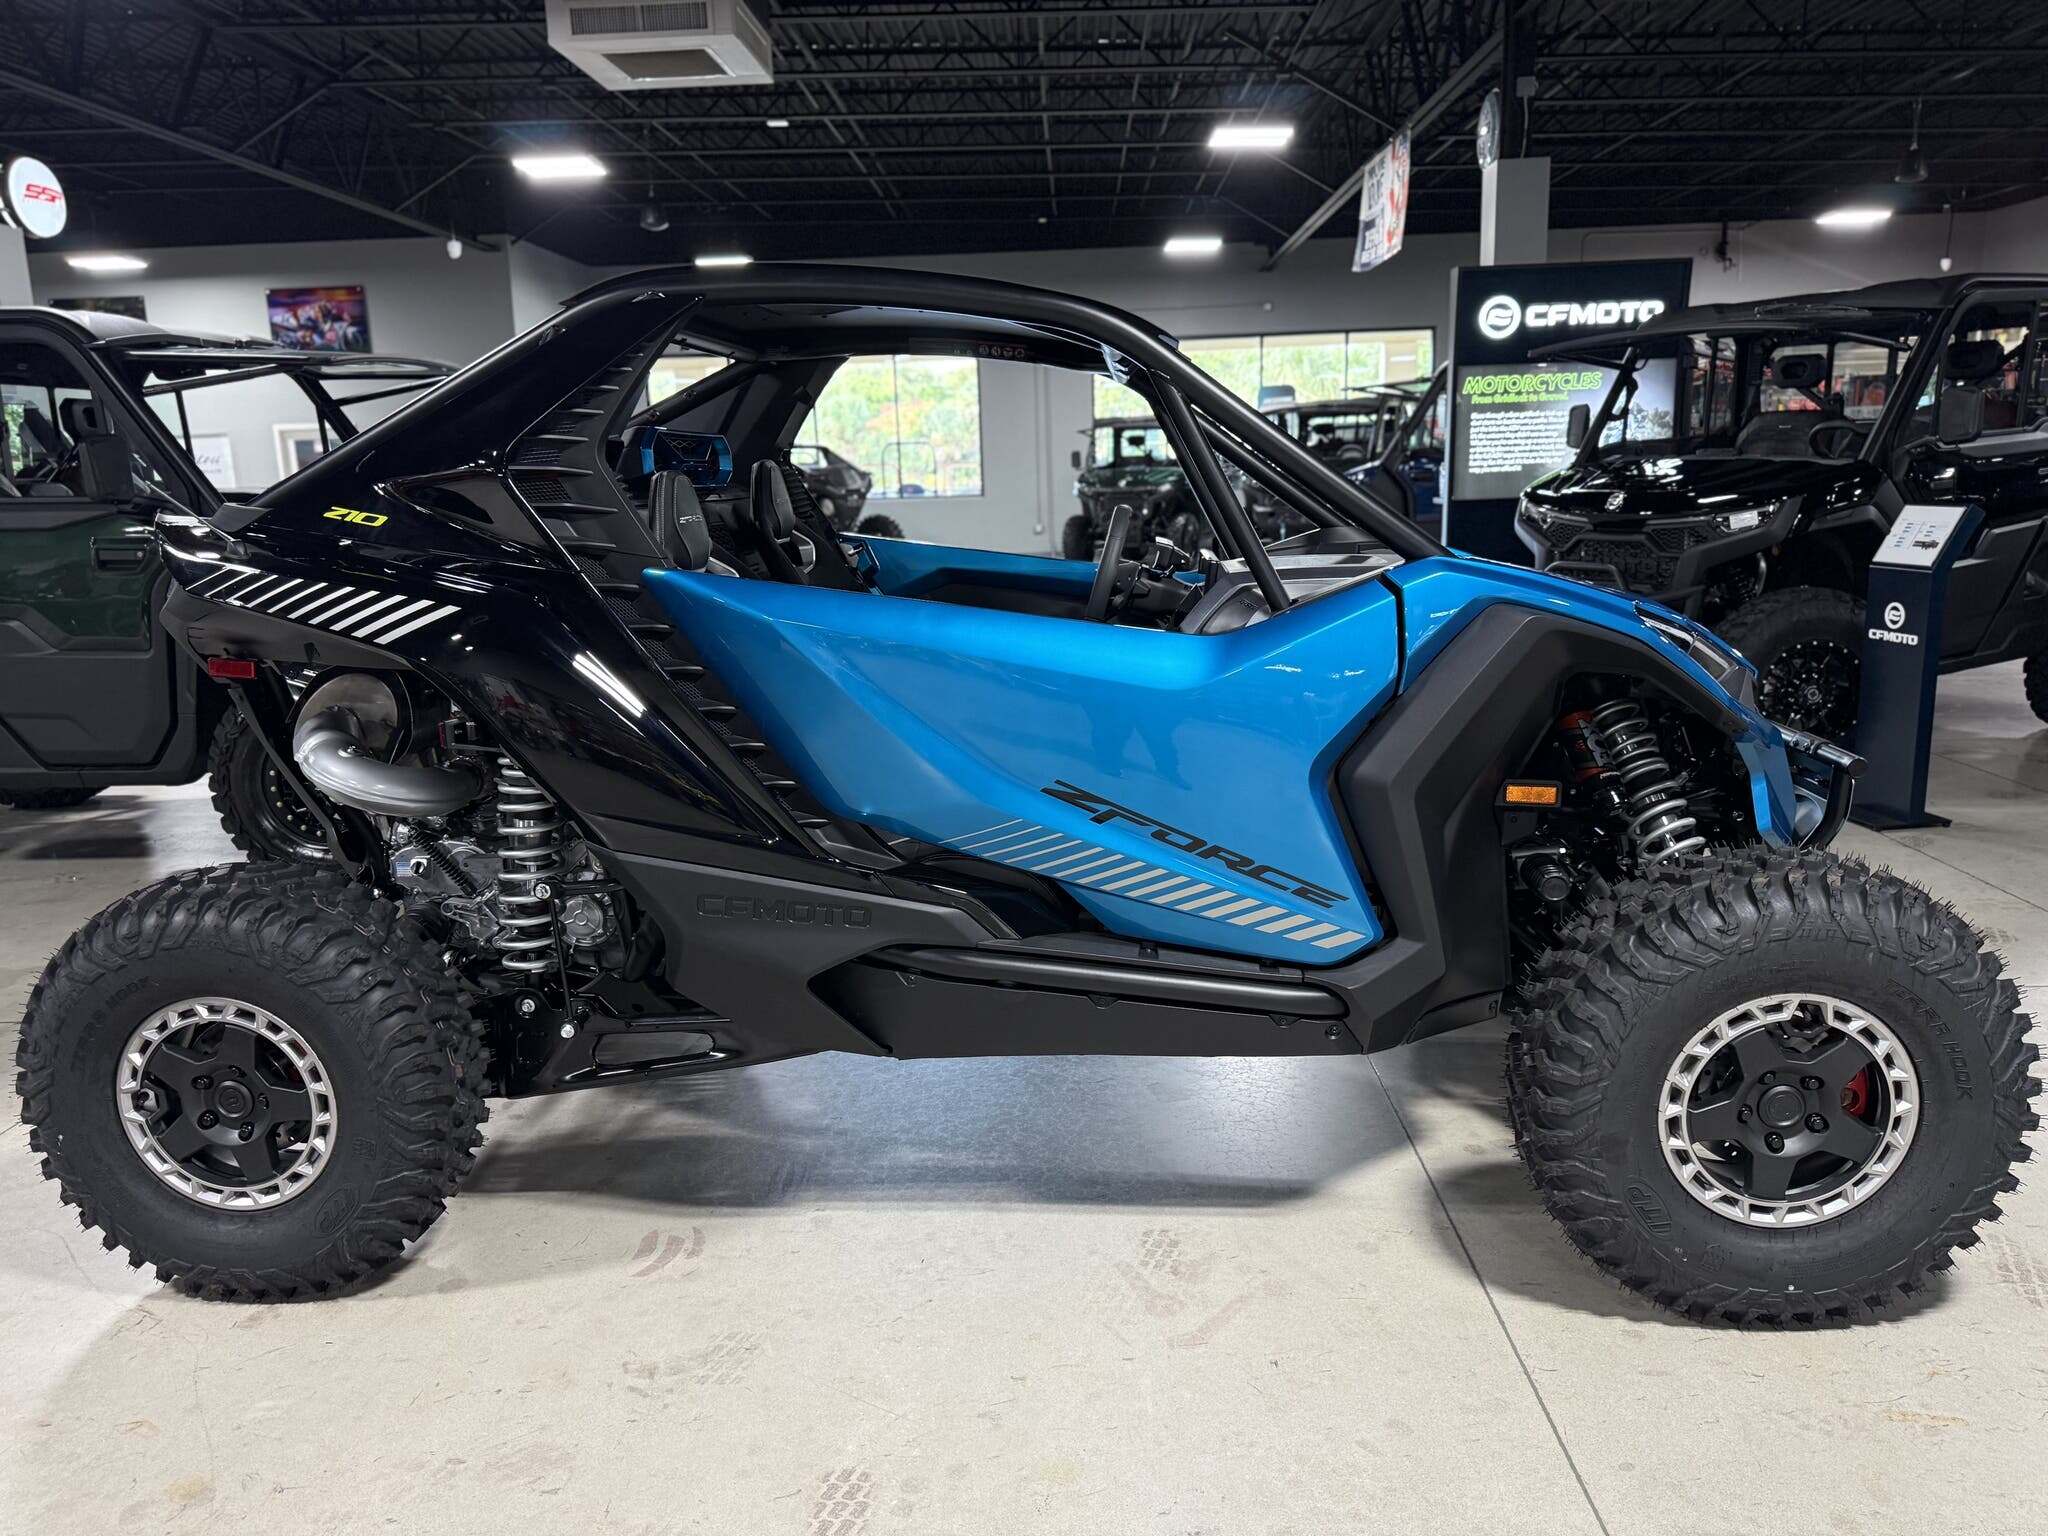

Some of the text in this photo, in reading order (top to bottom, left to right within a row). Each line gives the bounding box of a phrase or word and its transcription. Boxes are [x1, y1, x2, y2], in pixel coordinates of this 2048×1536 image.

[1525, 300, 1665, 327] CFMOTO
[1462, 371, 1602, 394] MOTORCYCLES
[323, 506, 389, 527] Z10
[1868, 628, 1919, 646] CFMOTO
[1040, 778, 1351, 909] ZFORCE
[697, 895, 873, 929] CFMOTO
